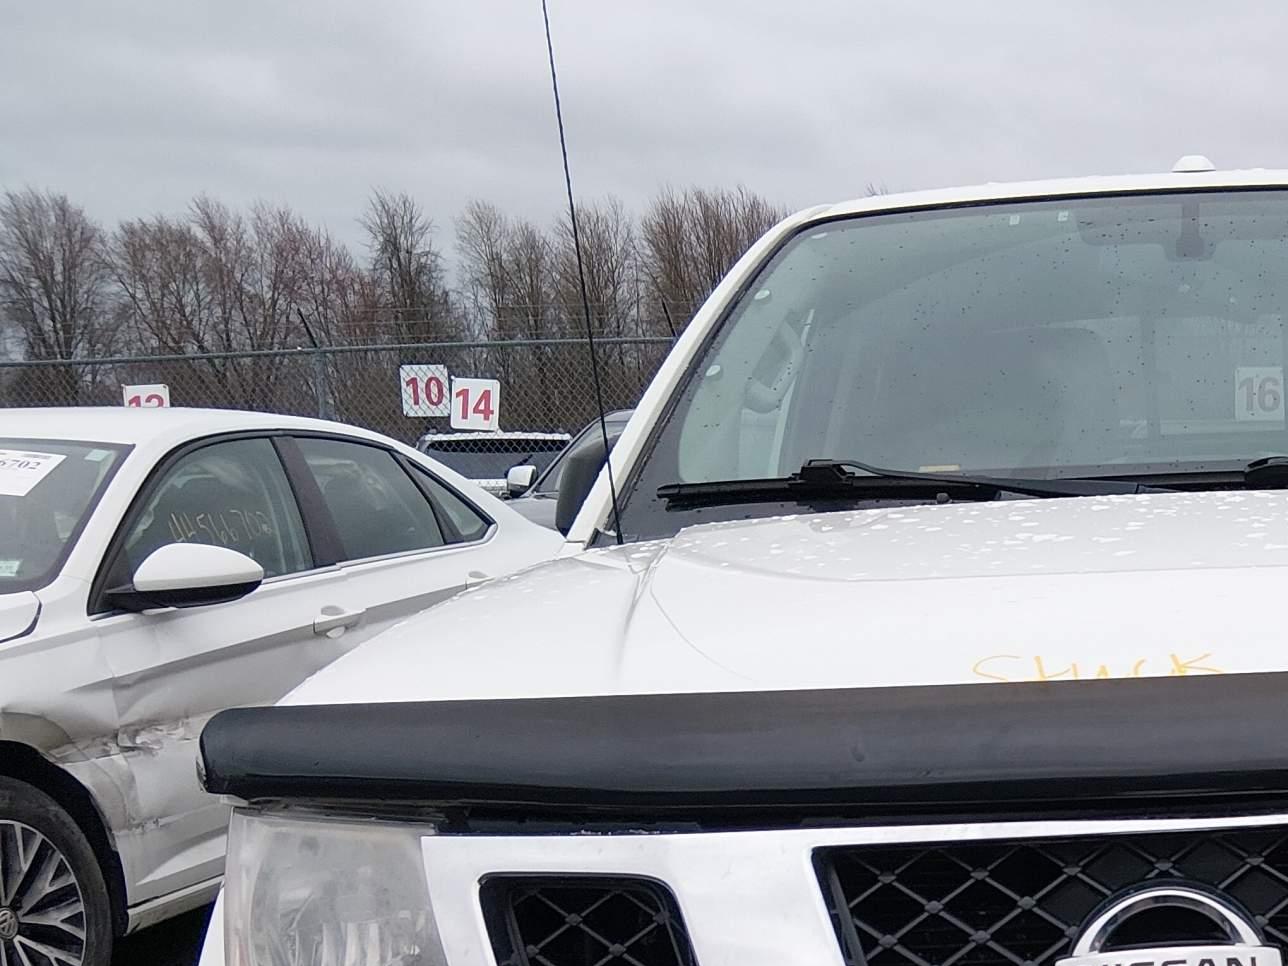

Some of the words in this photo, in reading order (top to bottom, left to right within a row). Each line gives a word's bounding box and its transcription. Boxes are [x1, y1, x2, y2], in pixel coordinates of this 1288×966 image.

[405, 376, 444, 407] 10
[455, 388, 495, 421] 14
[1238, 376, 1281, 413] 16
